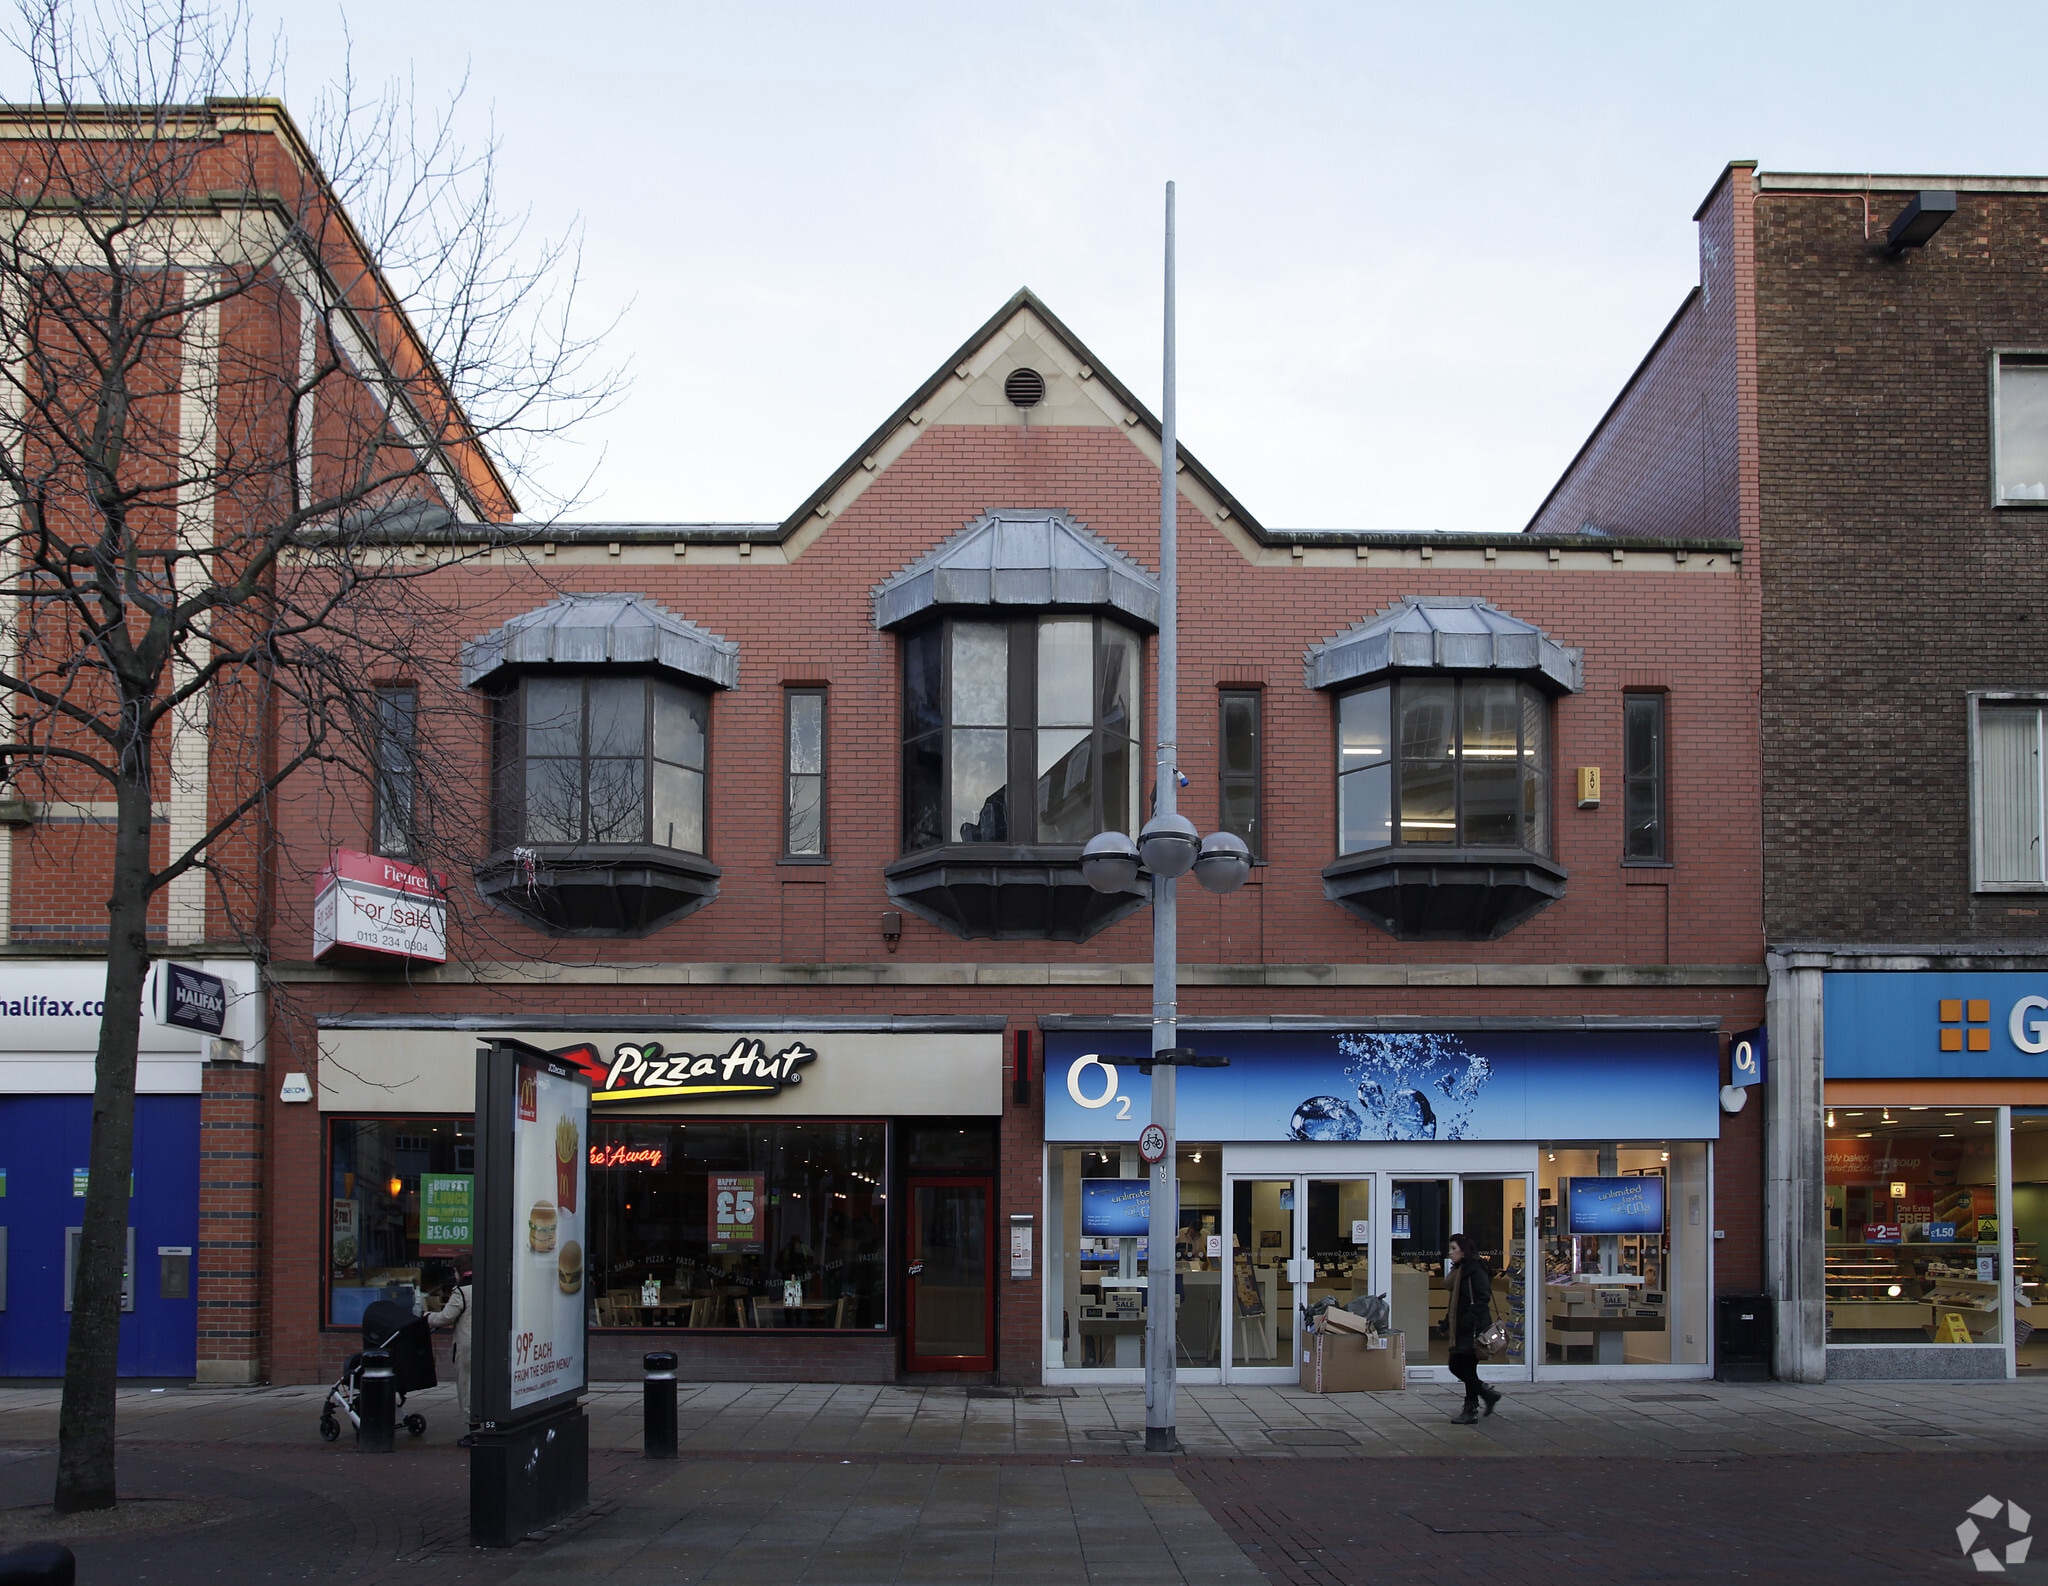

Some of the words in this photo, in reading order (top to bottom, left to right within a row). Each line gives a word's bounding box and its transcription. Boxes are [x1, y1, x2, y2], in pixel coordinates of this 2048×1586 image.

[384, 864, 435, 890] Fleuret
[353, 895, 384, 920] For
[393, 909, 431, 929] sale
[357, 930, 378, 944] 0113
[382, 935, 400, 948] 234
[176, 986, 224, 1012] HALIFAX
[605, 1045, 717, 1091] Pizza
[720, 1041, 812, 1081] Hut
[1824, 1154, 1842, 1163] shly
[1843, 1153, 1869, 1162] baked
[1893, 1158, 1921, 1170] soup
[433, 1179, 470, 1192] BUFFET
[717, 1178, 737, 1186] HAPPY
[434, 1192, 469, 1205] LUNCH
[1111, 1189, 1151, 1204] unlimite
[1598, 1184, 1642, 1201] unlimited
[717, 1191, 755, 1224] £5
[1136, 1198, 1150, 1206] tex
[1897, 1204, 1911, 1212] One
[1912, 1204, 1931, 1212] Extra
[427, 1208, 469, 1217] UNLIMITED
[1897, 1213, 1931, 1224] FREE
[433, 1225, 469, 1241] £6.99
[717, 1231, 731, 1239] SIDE
[1877, 1225, 1887, 1238] 2
[1930, 1227, 1955, 1238] £1.50
[645, 1255, 665, 1264] PIZZA
[675, 1255, 696, 1267] PASTA
[824, 1258, 845, 1272] PIZZA
[858, 1253, 880, 1264] PASTA
[613, 1259, 635, 1273] SALAD
[706, 1264, 726, 1278] SALAD
[735, 1276, 754, 1287] PIZZA
[765, 1279, 784, 1288] PASTA
[533, 1341, 553, 1361] EACH
[514, 1367, 529, 1382] FROM
[530, 1364, 540, 1378] THE
[540, 1360, 555, 1376] SAVER
